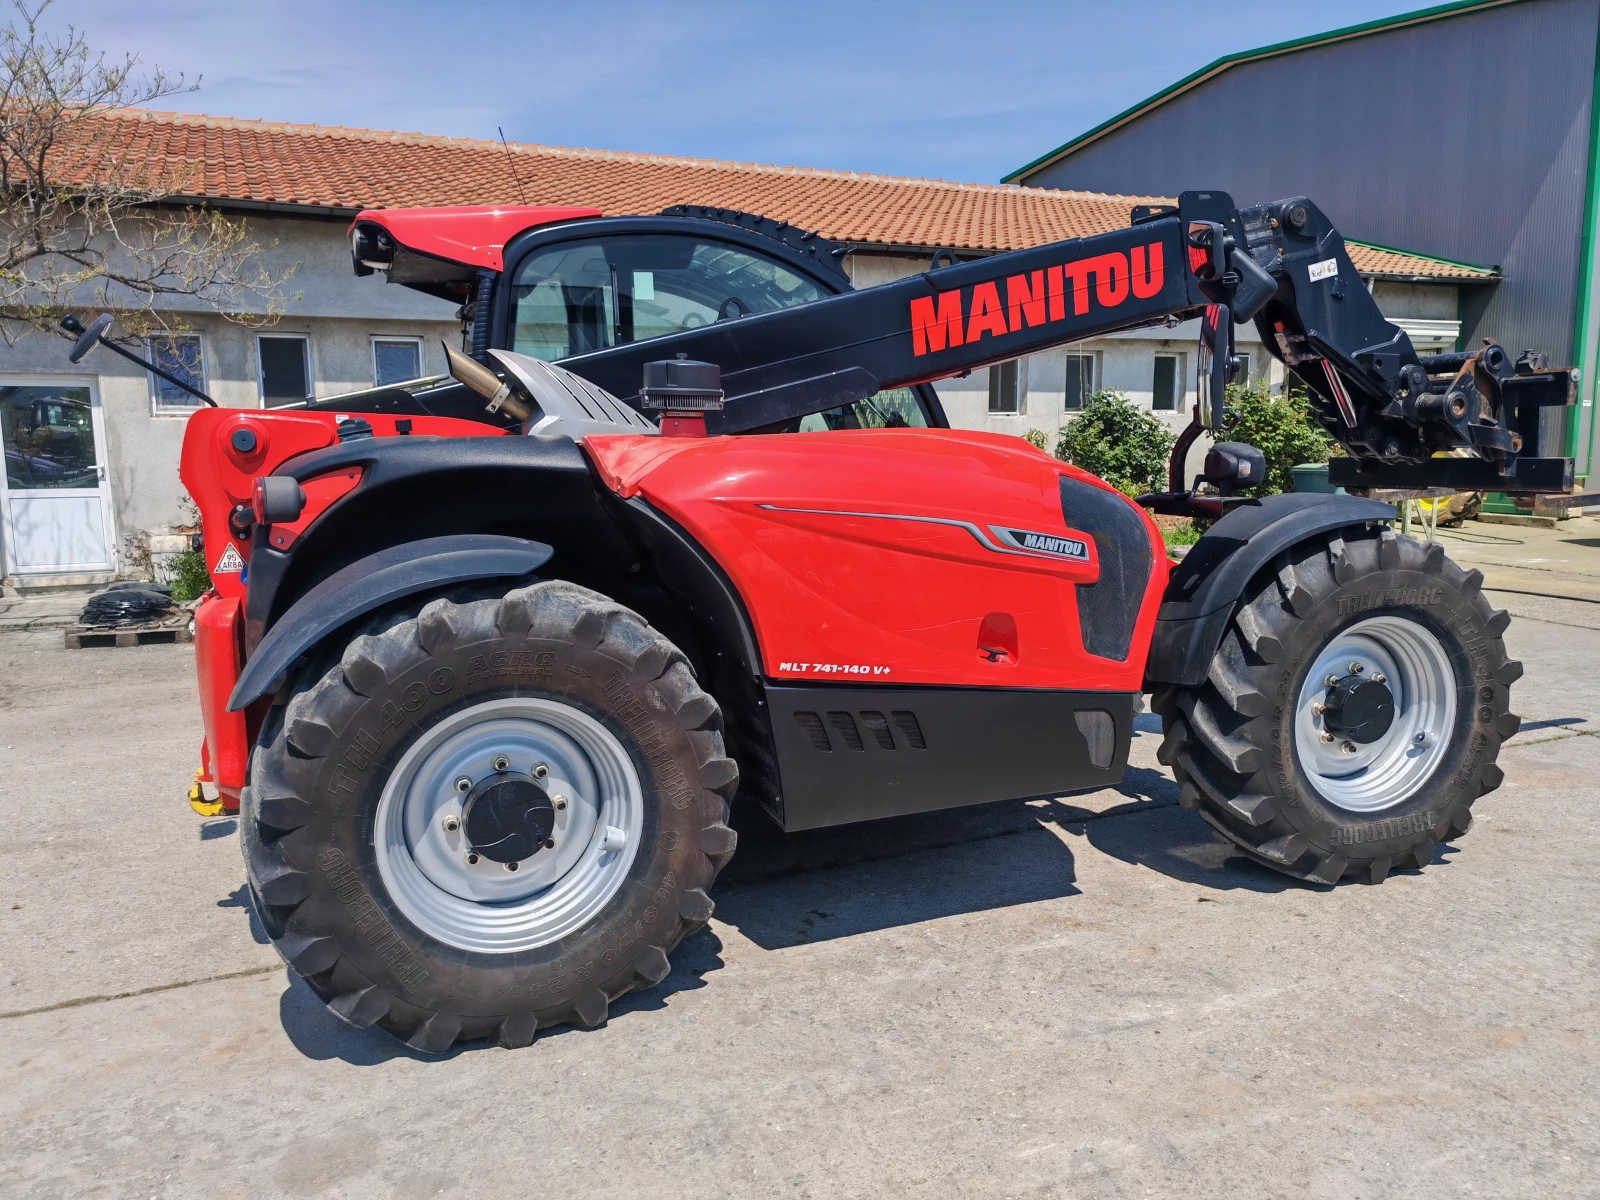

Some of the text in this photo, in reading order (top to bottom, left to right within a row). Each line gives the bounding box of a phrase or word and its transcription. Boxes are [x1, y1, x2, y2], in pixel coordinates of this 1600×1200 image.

[910, 241, 1164, 357] MANITOU
[227, 553, 237, 561] 95
[1024, 534, 1083, 555] MANITOU
[779, 662, 891, 674] MLT 741-140 V+
[1476, 665, 1495, 726] 400
[328, 650, 557, 794] TH 400 AGRO
[602, 668, 697, 811] TRELLEBORG
[1329, 811, 1436, 846] TRELLEBORG
[316, 848, 430, 996] TRELLEBORG
